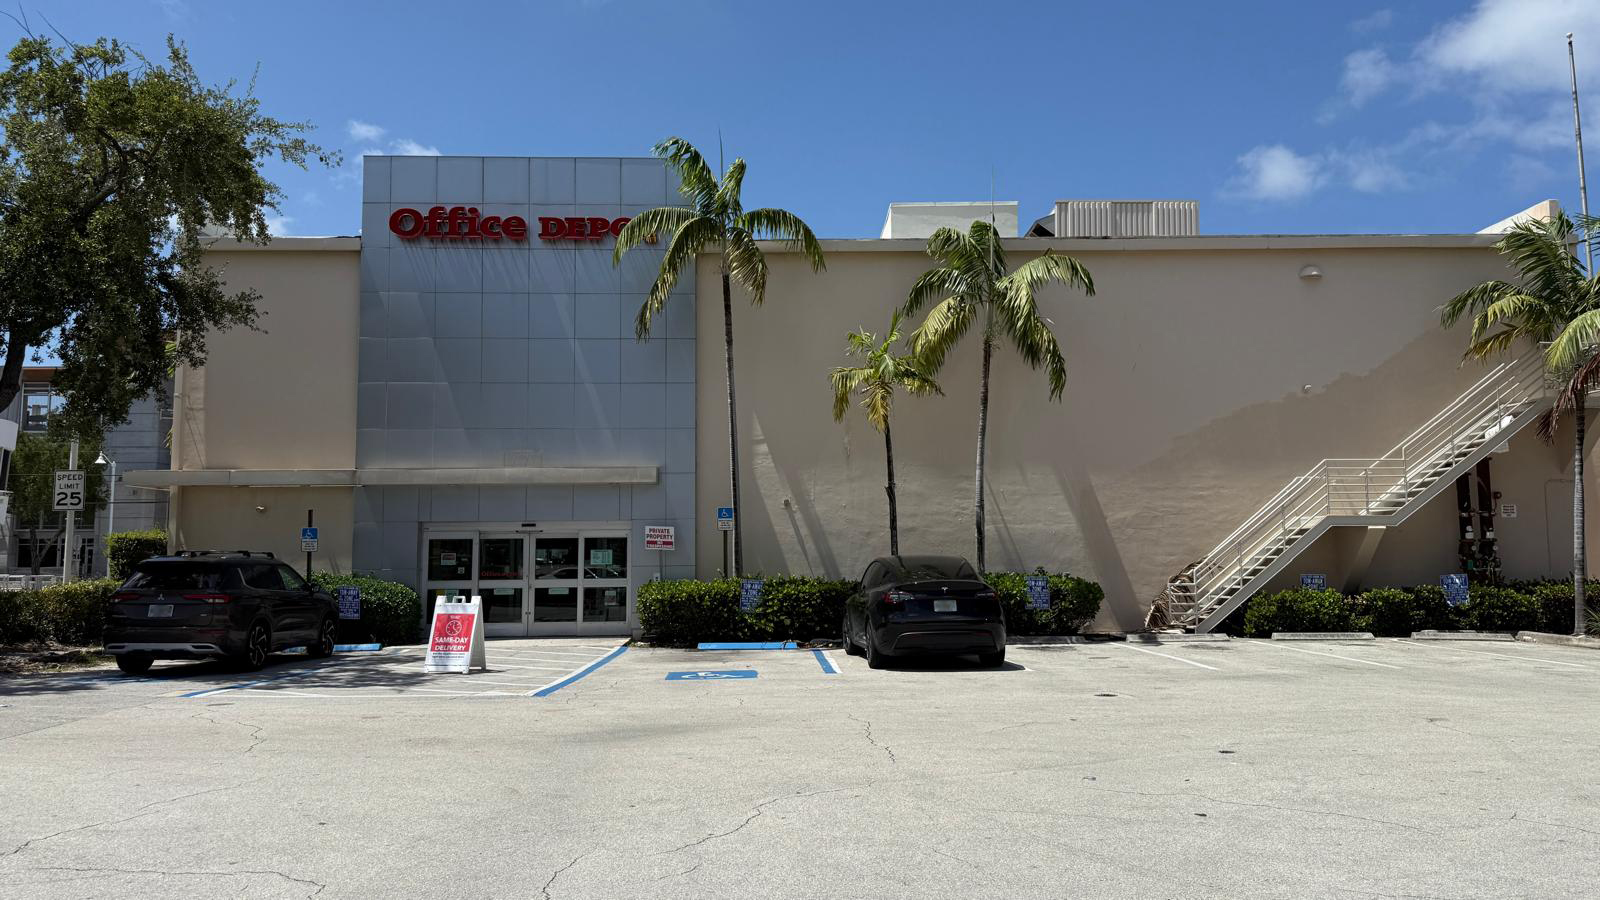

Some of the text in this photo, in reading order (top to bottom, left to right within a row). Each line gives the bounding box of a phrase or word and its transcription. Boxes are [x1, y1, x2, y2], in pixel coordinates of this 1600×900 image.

[389, 206, 632, 240] Office DEPO
[56, 492, 82, 506] 25
[435, 636, 468, 644] SAME-DAY
